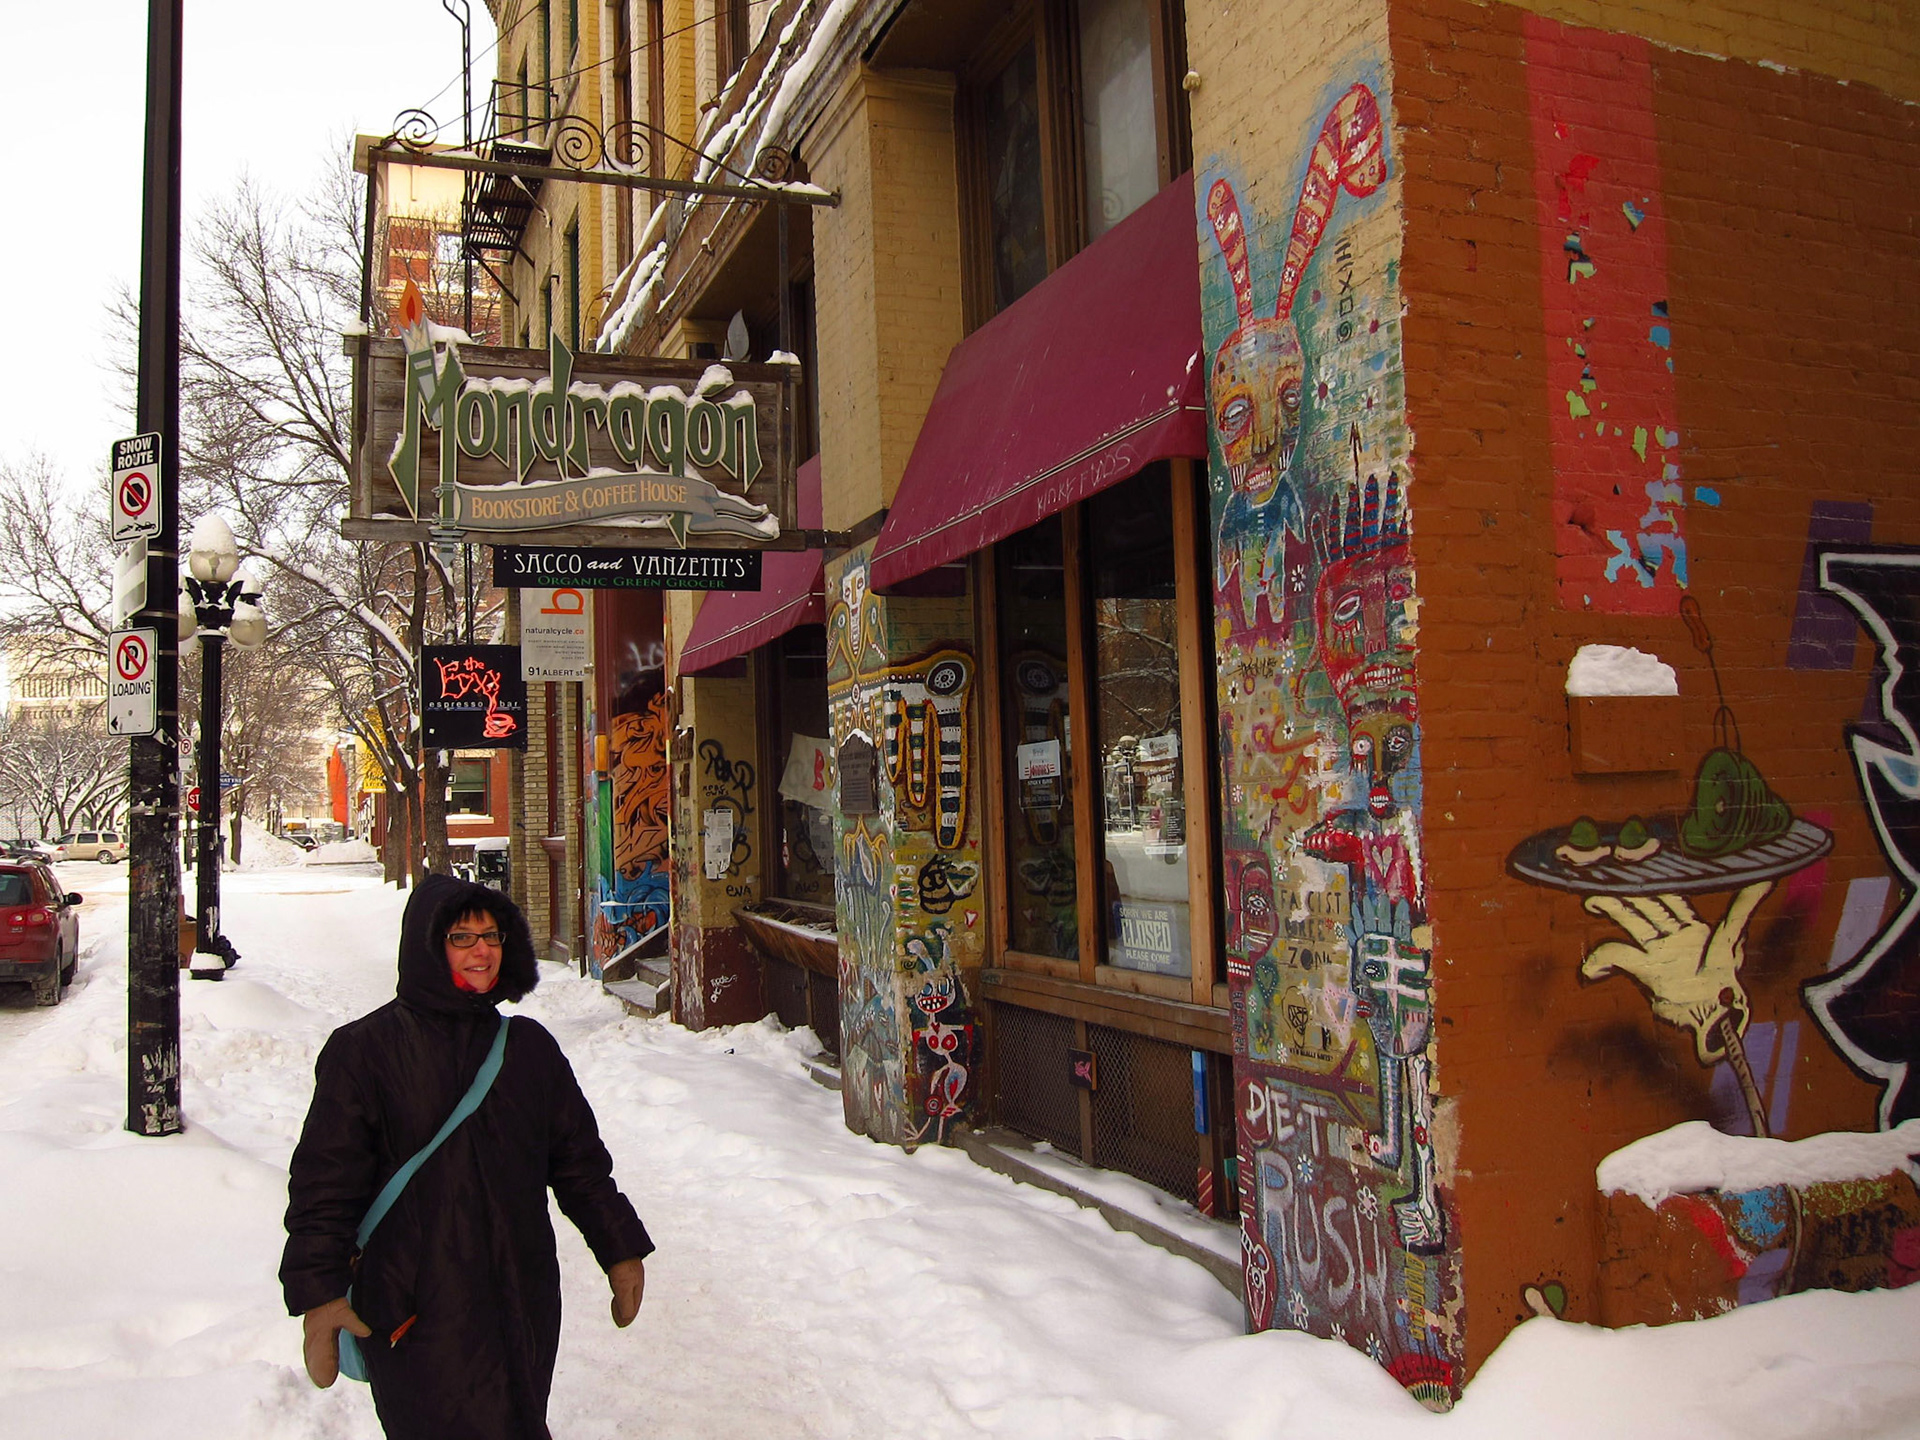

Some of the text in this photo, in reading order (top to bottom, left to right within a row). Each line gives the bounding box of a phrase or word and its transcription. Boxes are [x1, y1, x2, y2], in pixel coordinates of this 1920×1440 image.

[119, 437, 151, 455] SNOW
[117, 453, 154, 470] ROUTE
[471, 480, 689, 520] BOOKSTORE & COFFEE HOUSE
[514, 553, 746, 578] SACCO and VANZETTI'S
[537, 575, 725, 589] ORGANIC GREEN GROCER
[525, 627, 585, 636] naturalcycle.ca
[463, 656, 484, 671] the
[528, 667, 540, 676] 91
[112, 680, 151, 697] LOADING
[429, 701, 484, 710] espresso
[189, 794, 200, 804] ST
[1281, 890, 1342, 914] FACIST
[1119, 908, 1169, 921] SORRY WE ARE
[1121, 918, 1171, 952] CLOSED
[1126, 949, 1170, 965] PLEASE COME
